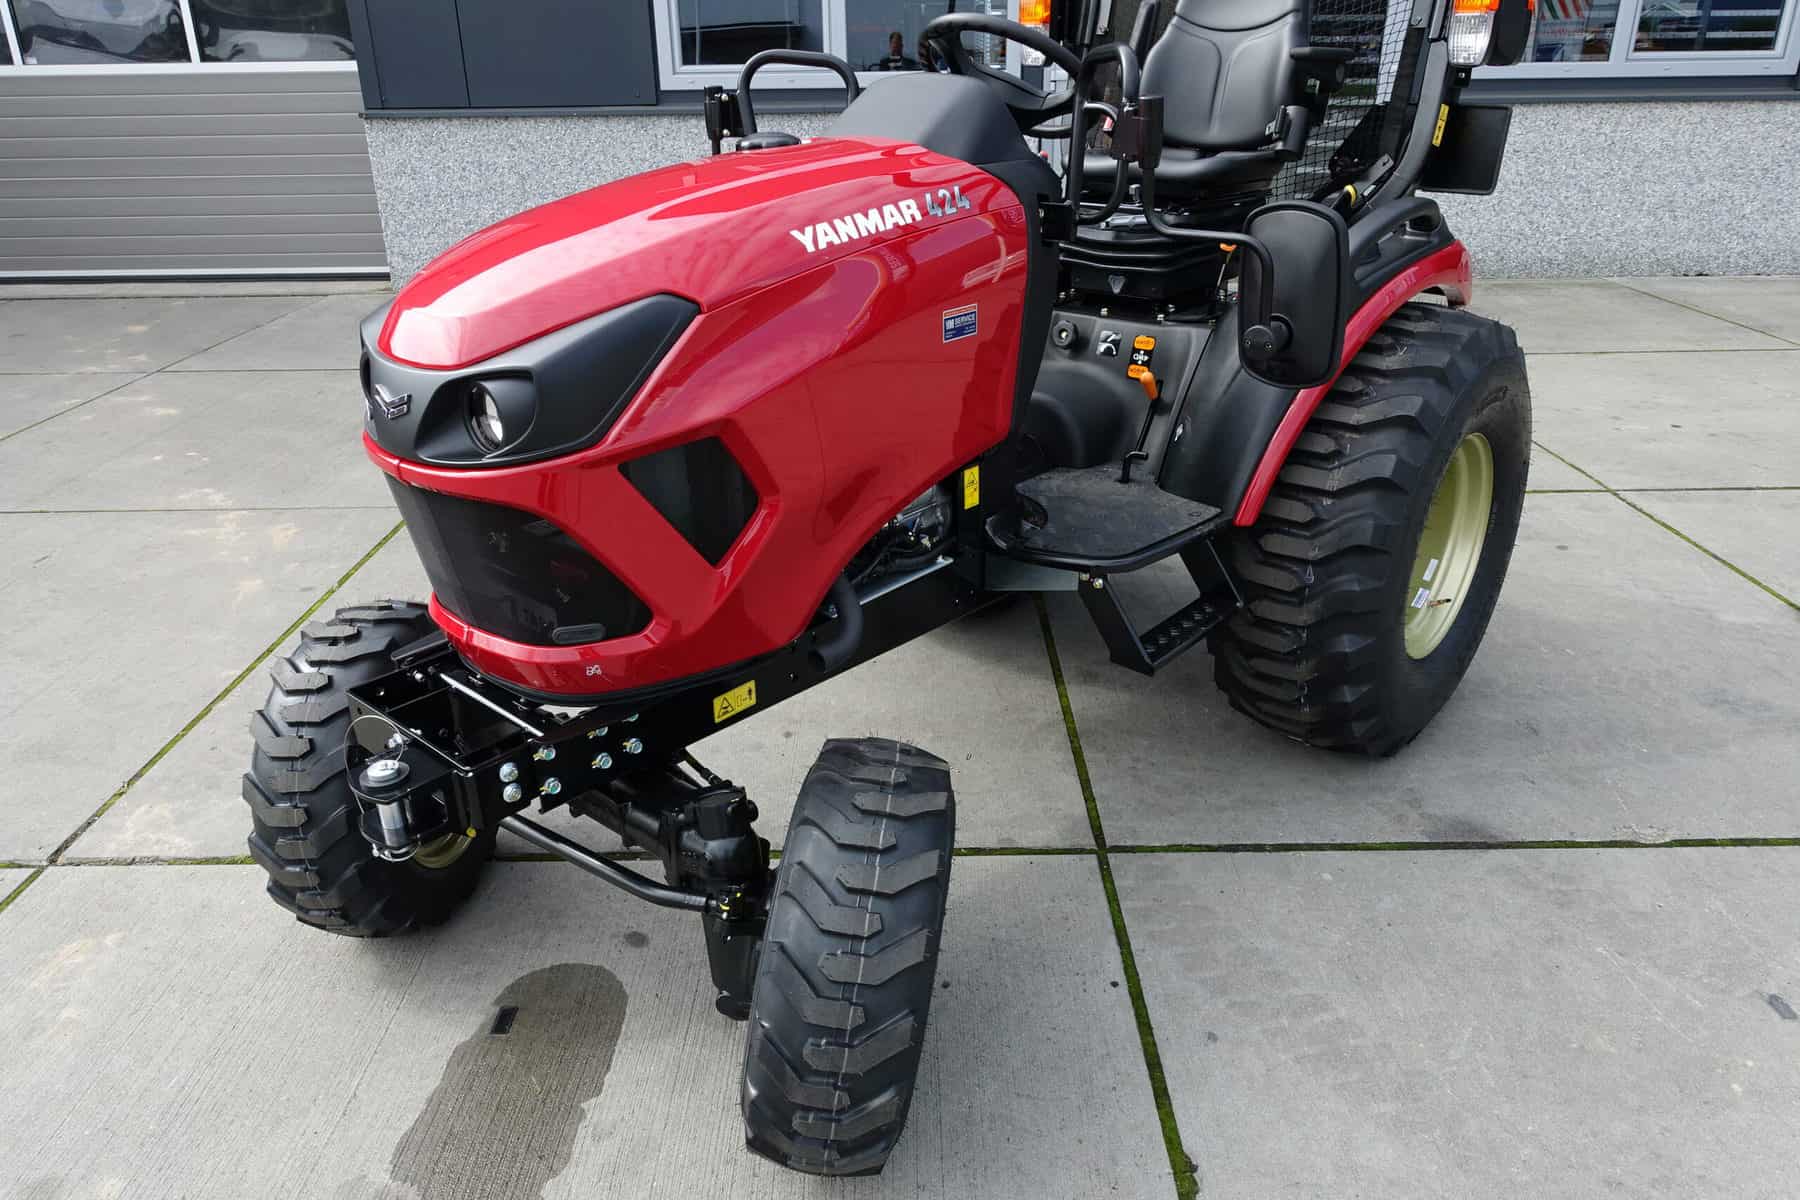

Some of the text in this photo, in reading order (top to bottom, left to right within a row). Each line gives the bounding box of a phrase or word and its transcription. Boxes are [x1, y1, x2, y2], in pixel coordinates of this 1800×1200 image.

[790, 185, 970, 252] YANMAR 424
[955, 313, 976, 325] SERVICE
